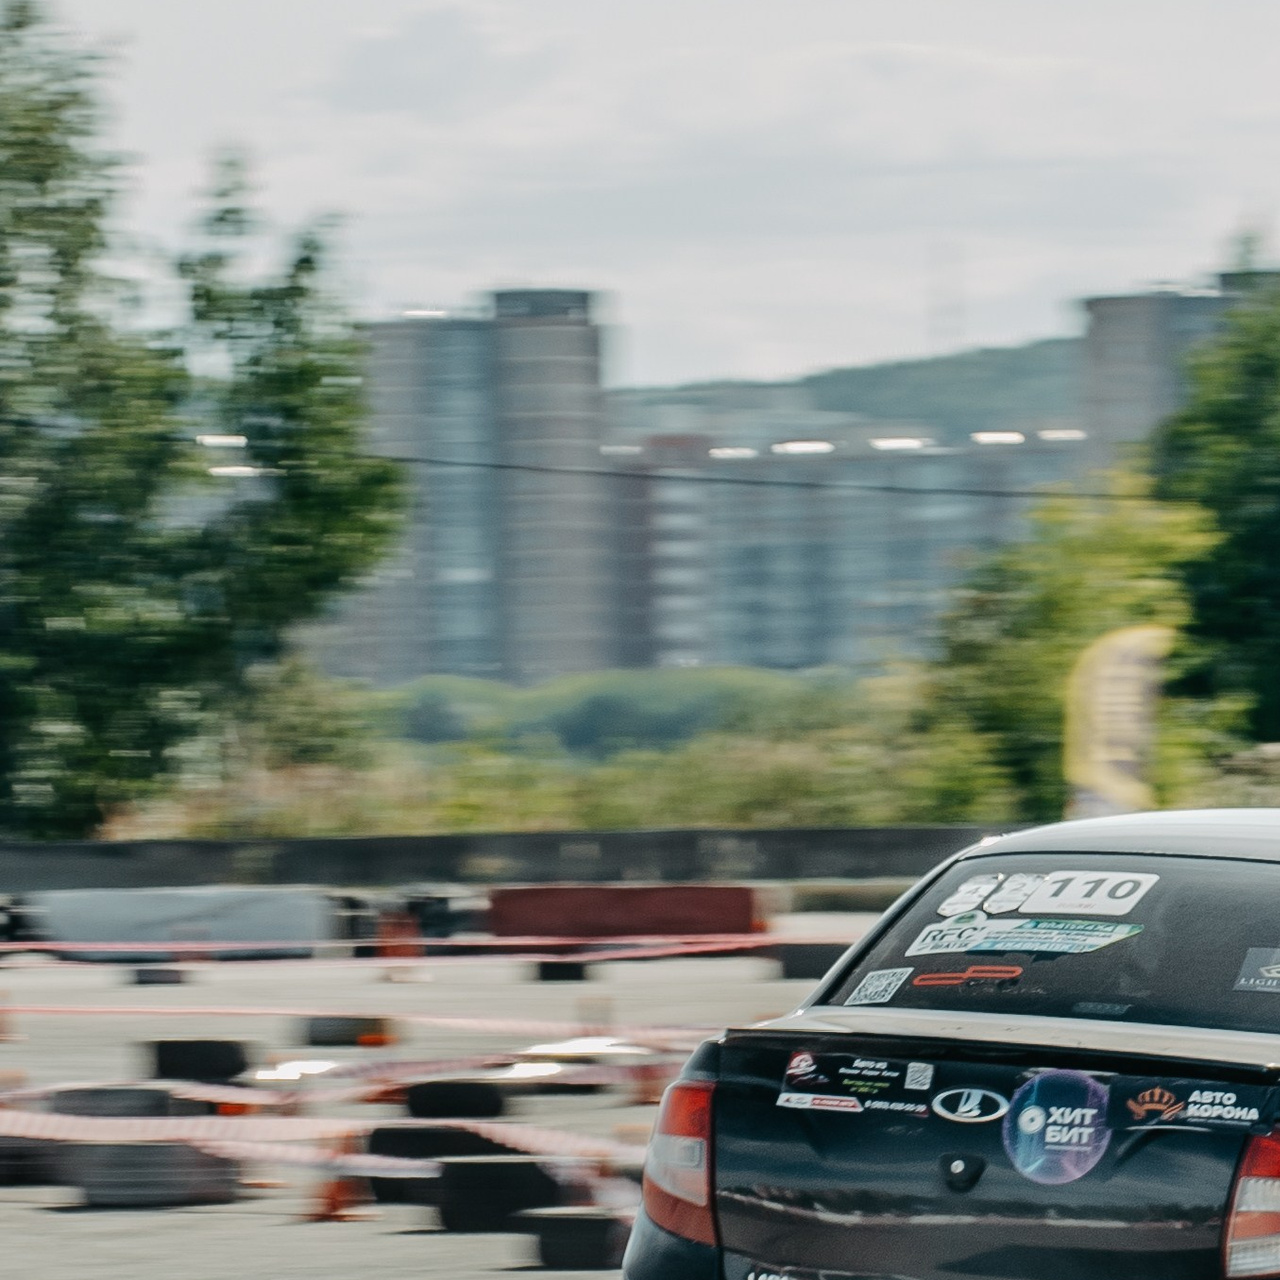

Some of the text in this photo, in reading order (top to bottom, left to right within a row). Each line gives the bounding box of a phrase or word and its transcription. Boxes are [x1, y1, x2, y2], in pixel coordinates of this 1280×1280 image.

[1050, 877, 1143, 900] 110
[1188, 1089, 1237, 1106] АВТО
[1046, 1106, 1098, 1126] ХИТ
[1186, 1103, 1260, 1121] КОРОНА
[1044, 1125, 1095, 1145] БИТ
